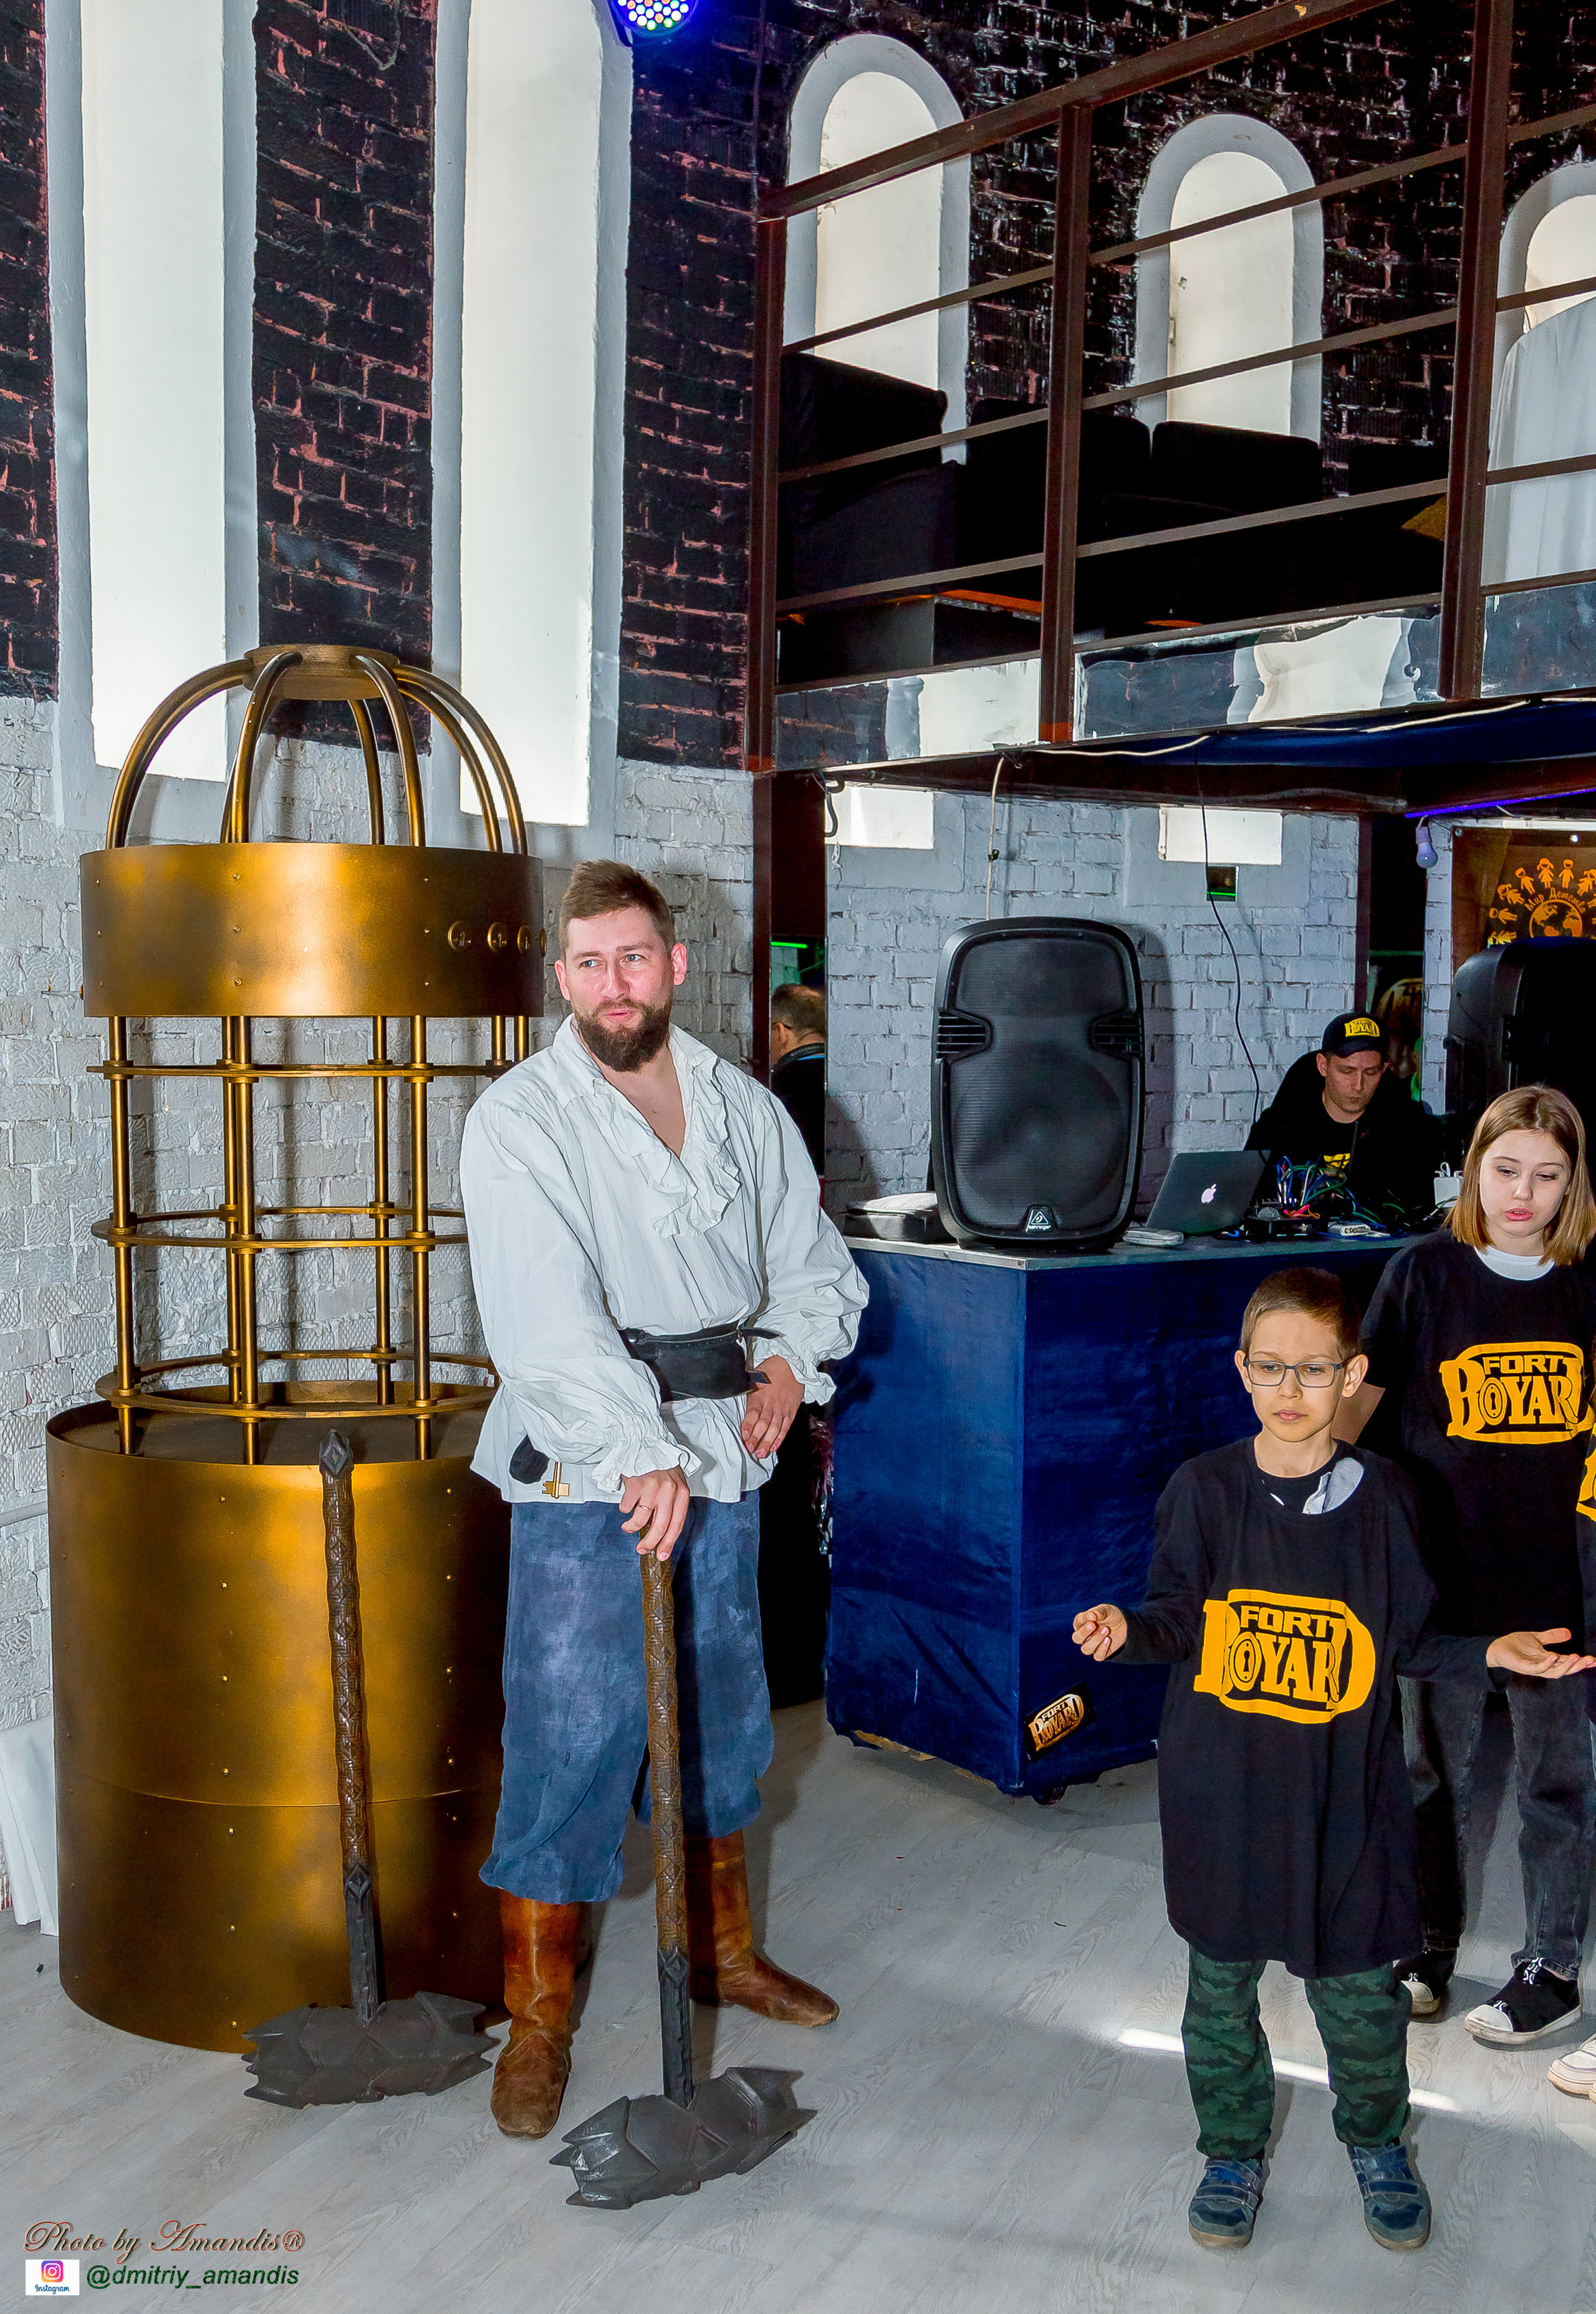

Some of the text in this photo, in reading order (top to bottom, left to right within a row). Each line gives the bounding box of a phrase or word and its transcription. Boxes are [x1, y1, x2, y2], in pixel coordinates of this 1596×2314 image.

[1483, 1355, 1564, 1375] FORT
[1240, 1605, 1332, 1638] FORT
[1193, 1599, 1375, 1716] BOYARD
[1028, 1695, 1084, 1751] BOYARD
[1042, 1701, 1069, 1721] FORT
